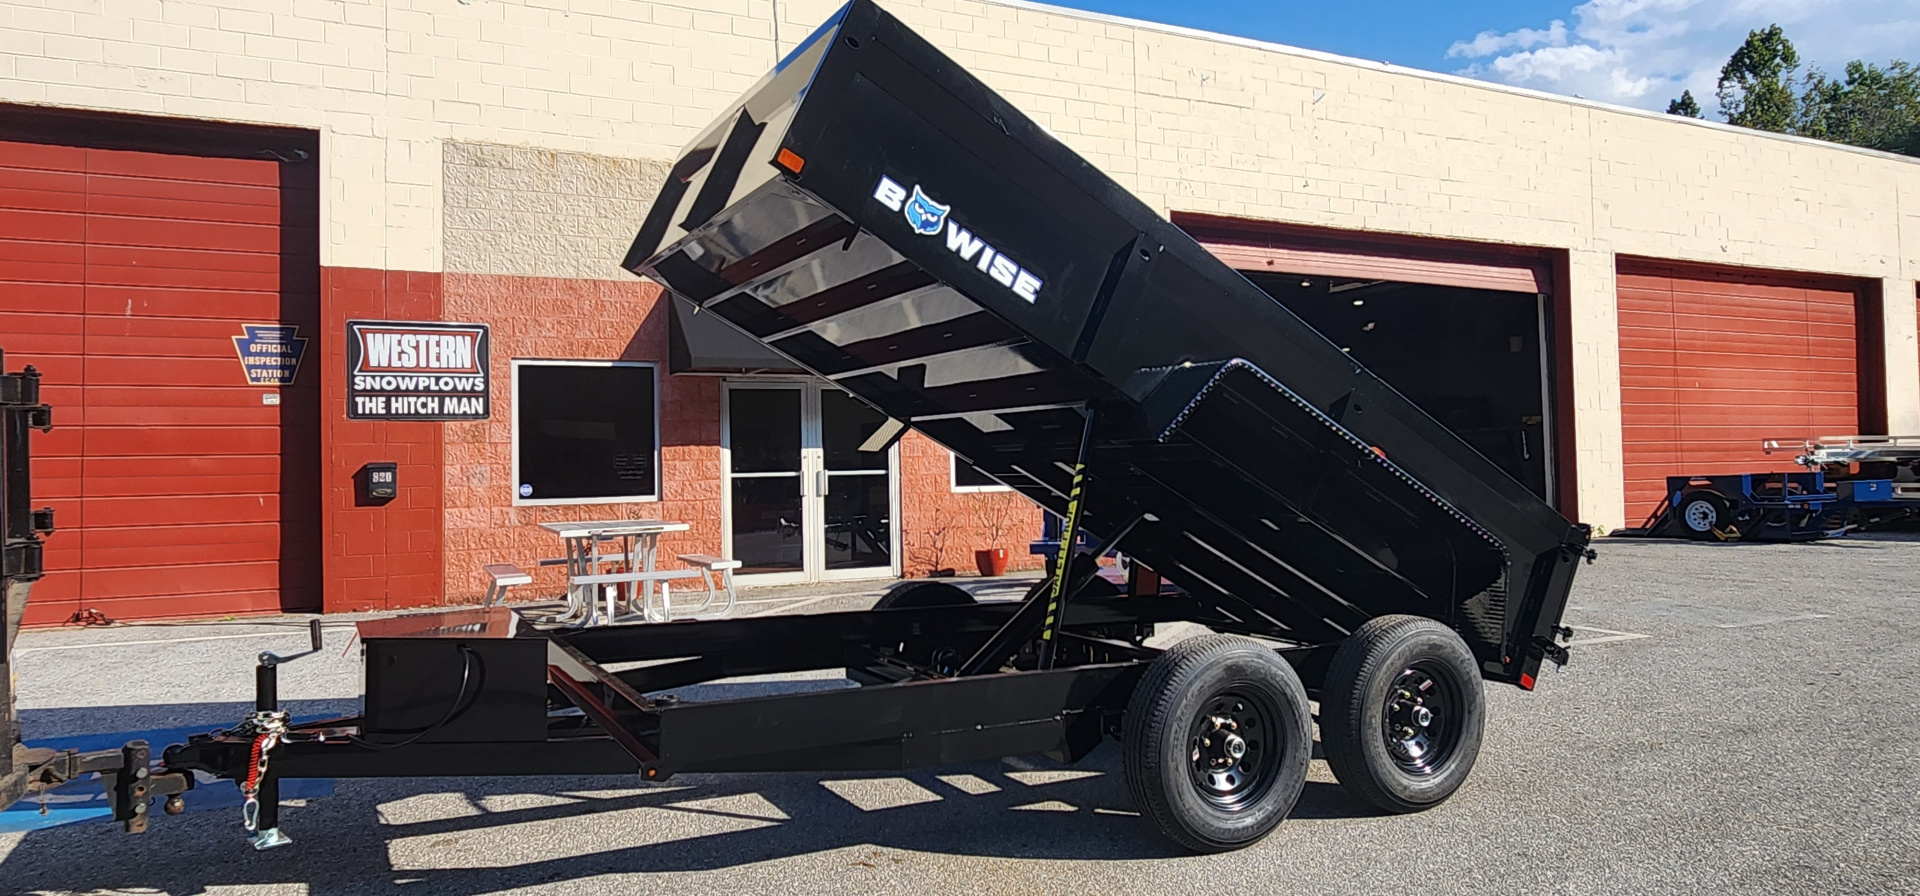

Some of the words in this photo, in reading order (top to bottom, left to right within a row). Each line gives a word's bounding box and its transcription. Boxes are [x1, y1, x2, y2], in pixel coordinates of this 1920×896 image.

[249, 343, 293, 353] OFFICIAL
[366, 333, 472, 369] WESTERN
[244, 356, 297, 366] INSPECTION
[250, 368, 290, 378] STATION
[353, 376, 485, 391] SNOWPLOWS
[355, 396, 386, 414] THE
[390, 396, 439, 415] HITCH
[443, 397, 484, 415] MAN
